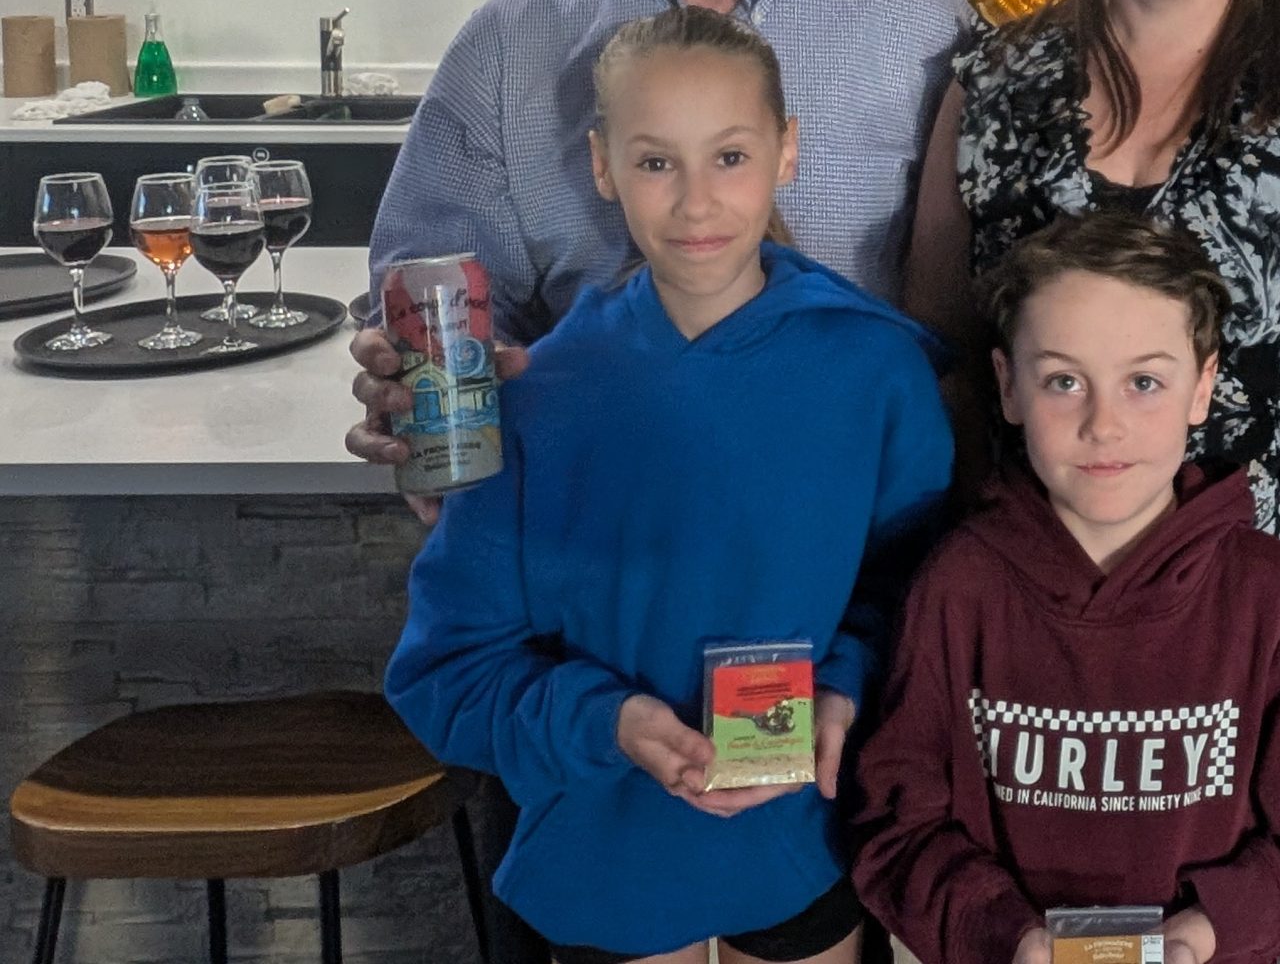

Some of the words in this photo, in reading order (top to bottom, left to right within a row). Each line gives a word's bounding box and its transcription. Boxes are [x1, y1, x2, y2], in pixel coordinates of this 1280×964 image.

[1017, 789, 1030, 805] IN
[1033, 789, 1097, 812] CALIFORNIA
[1101, 795, 1135, 812] SINCE
[1139, 793, 1181, 811] NINETY
